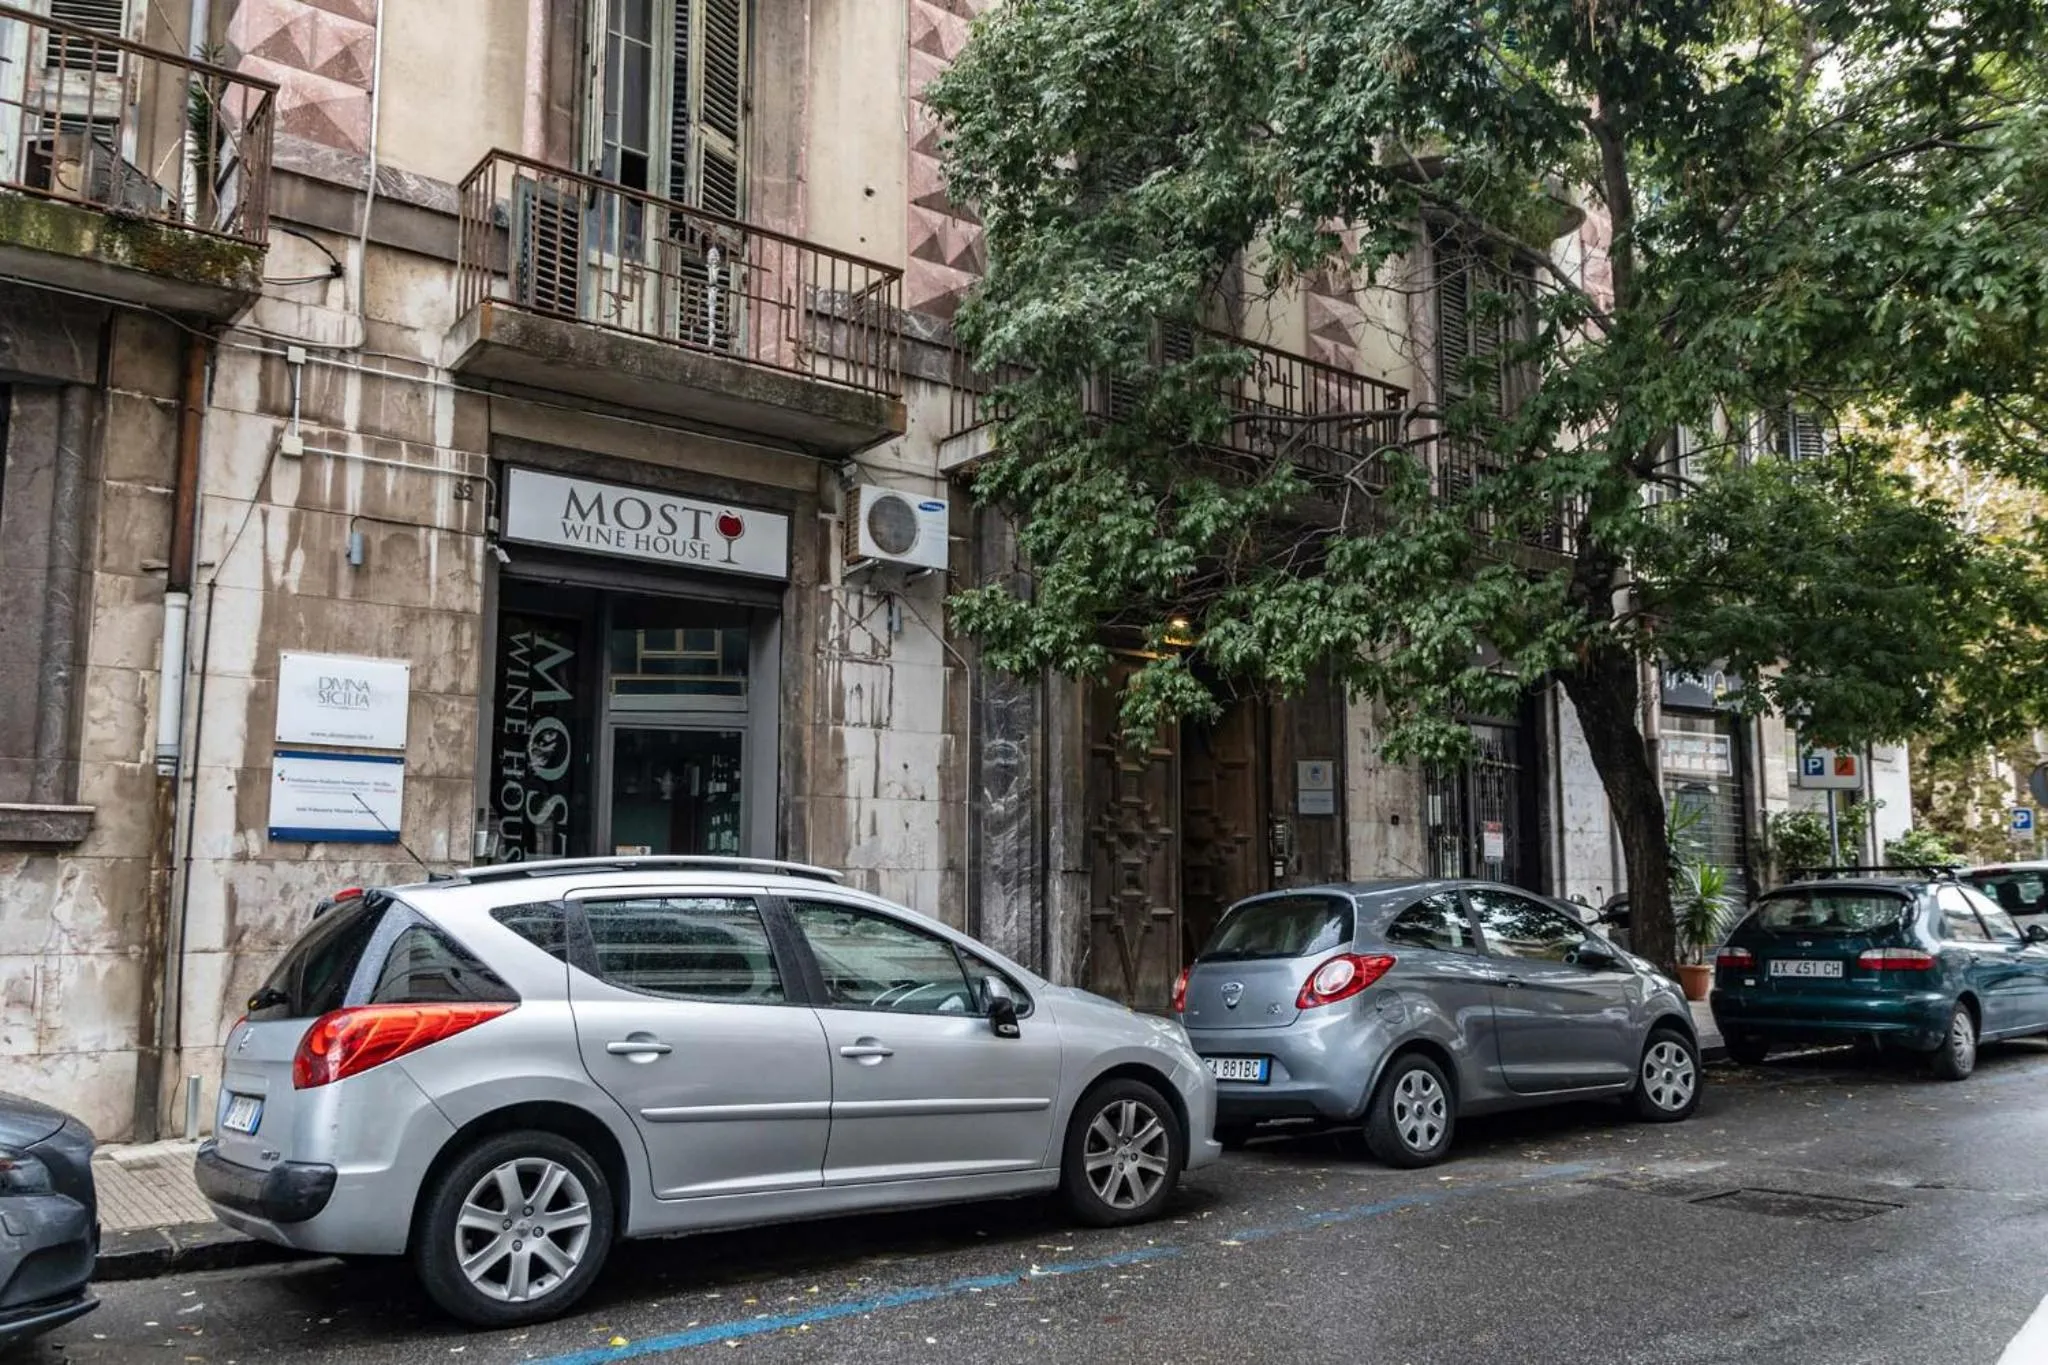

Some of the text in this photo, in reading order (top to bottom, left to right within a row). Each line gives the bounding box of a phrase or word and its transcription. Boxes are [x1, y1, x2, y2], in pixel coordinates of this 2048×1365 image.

[562, 521, 710, 561] WINE HOUSE
[319, 676, 371, 694] DIVINA
[318, 690, 370, 708] SICILIA
[498, 632, 532, 862] WINE HOUS
[1808, 758, 1822, 775] P
[2014, 811, 2029, 828] P
[1772, 962, 1841, 976] AX 451 CH
